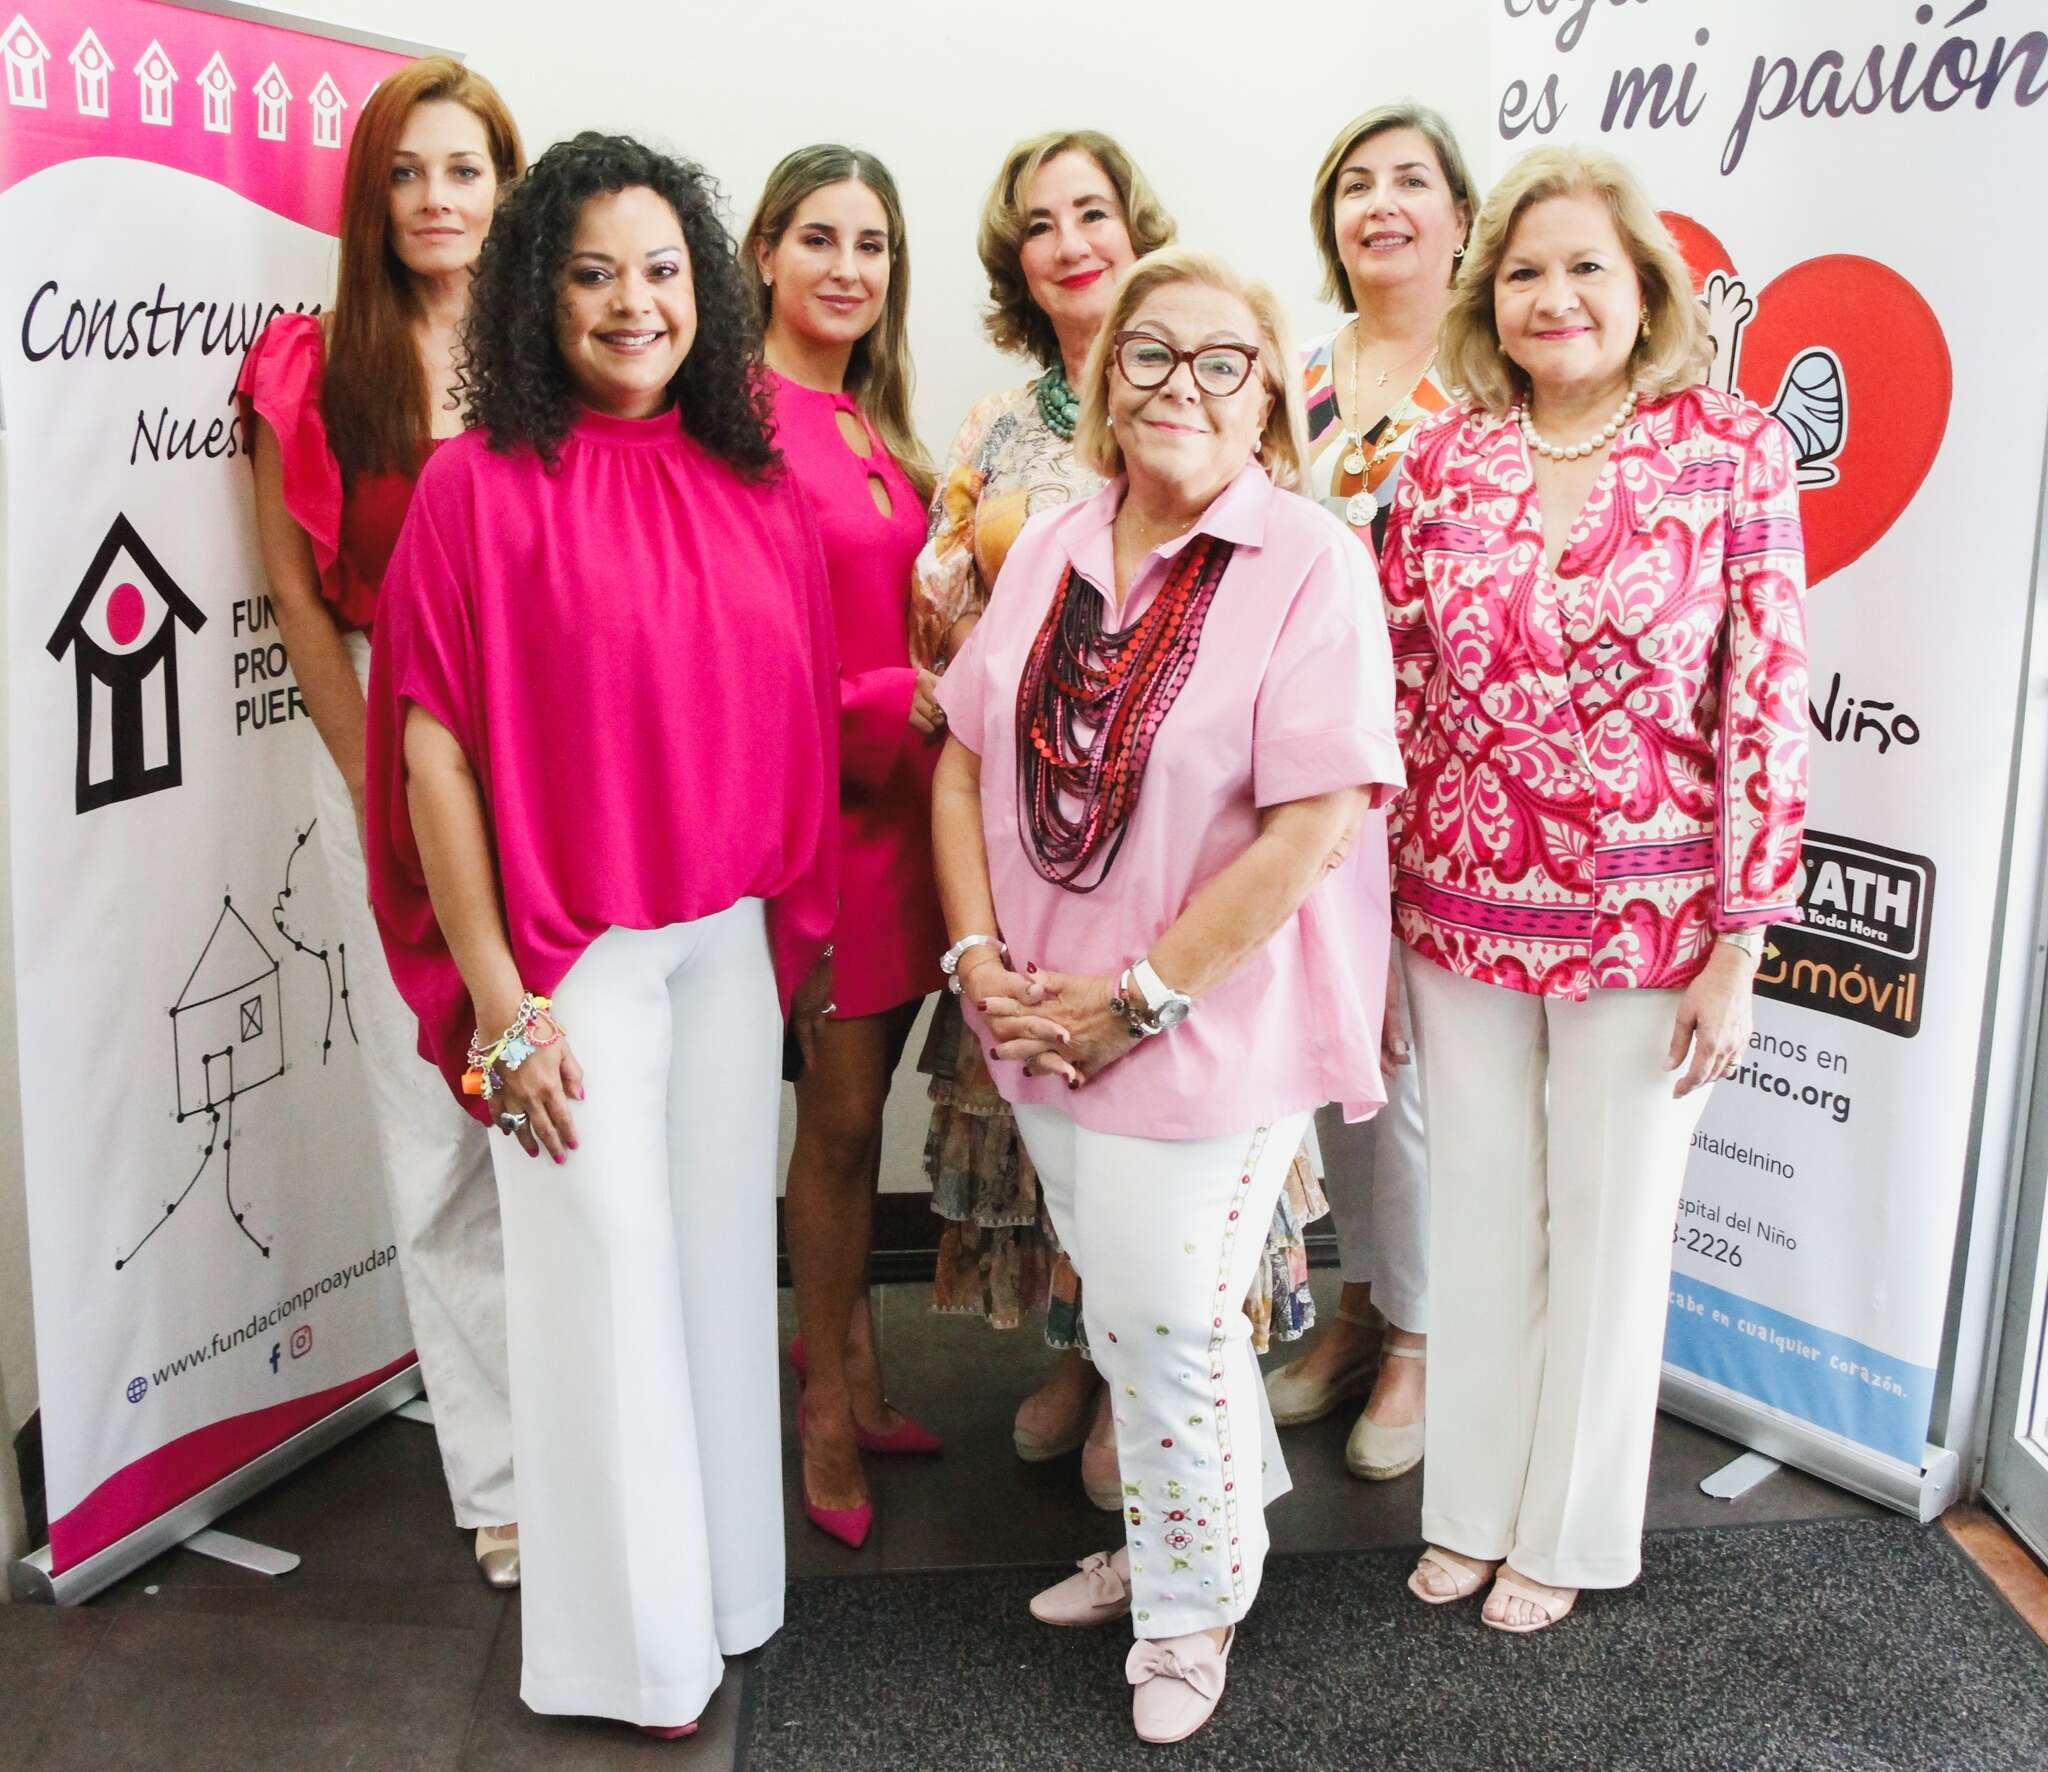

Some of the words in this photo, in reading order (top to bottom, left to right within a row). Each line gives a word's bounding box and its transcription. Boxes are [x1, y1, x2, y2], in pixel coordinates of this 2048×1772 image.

[1499, 73, 1567, 140] es
[1600, 27, 1708, 133] mi
[1720, 0, 2048, 177] pasión
[21, 280, 322, 406] Construy
[234, 642, 288, 689] PRO
[235, 686, 311, 737] PUER
[1809, 860, 1912, 929] ATH
[1808, 908, 1848, 931] Toda
[1850, 918, 1889, 943] Hora
[1791, 962, 1917, 1023] móvil
[1748, 1031, 1808, 1063] anos
[1816, 1050, 1848, 1075] en
[1725, 1211, 1752, 1235] del
[1757, 1221, 1798, 1251] Niño
[1711, 1309, 1729, 1328] en
[1737, 1319, 1821, 1362] cualquier
